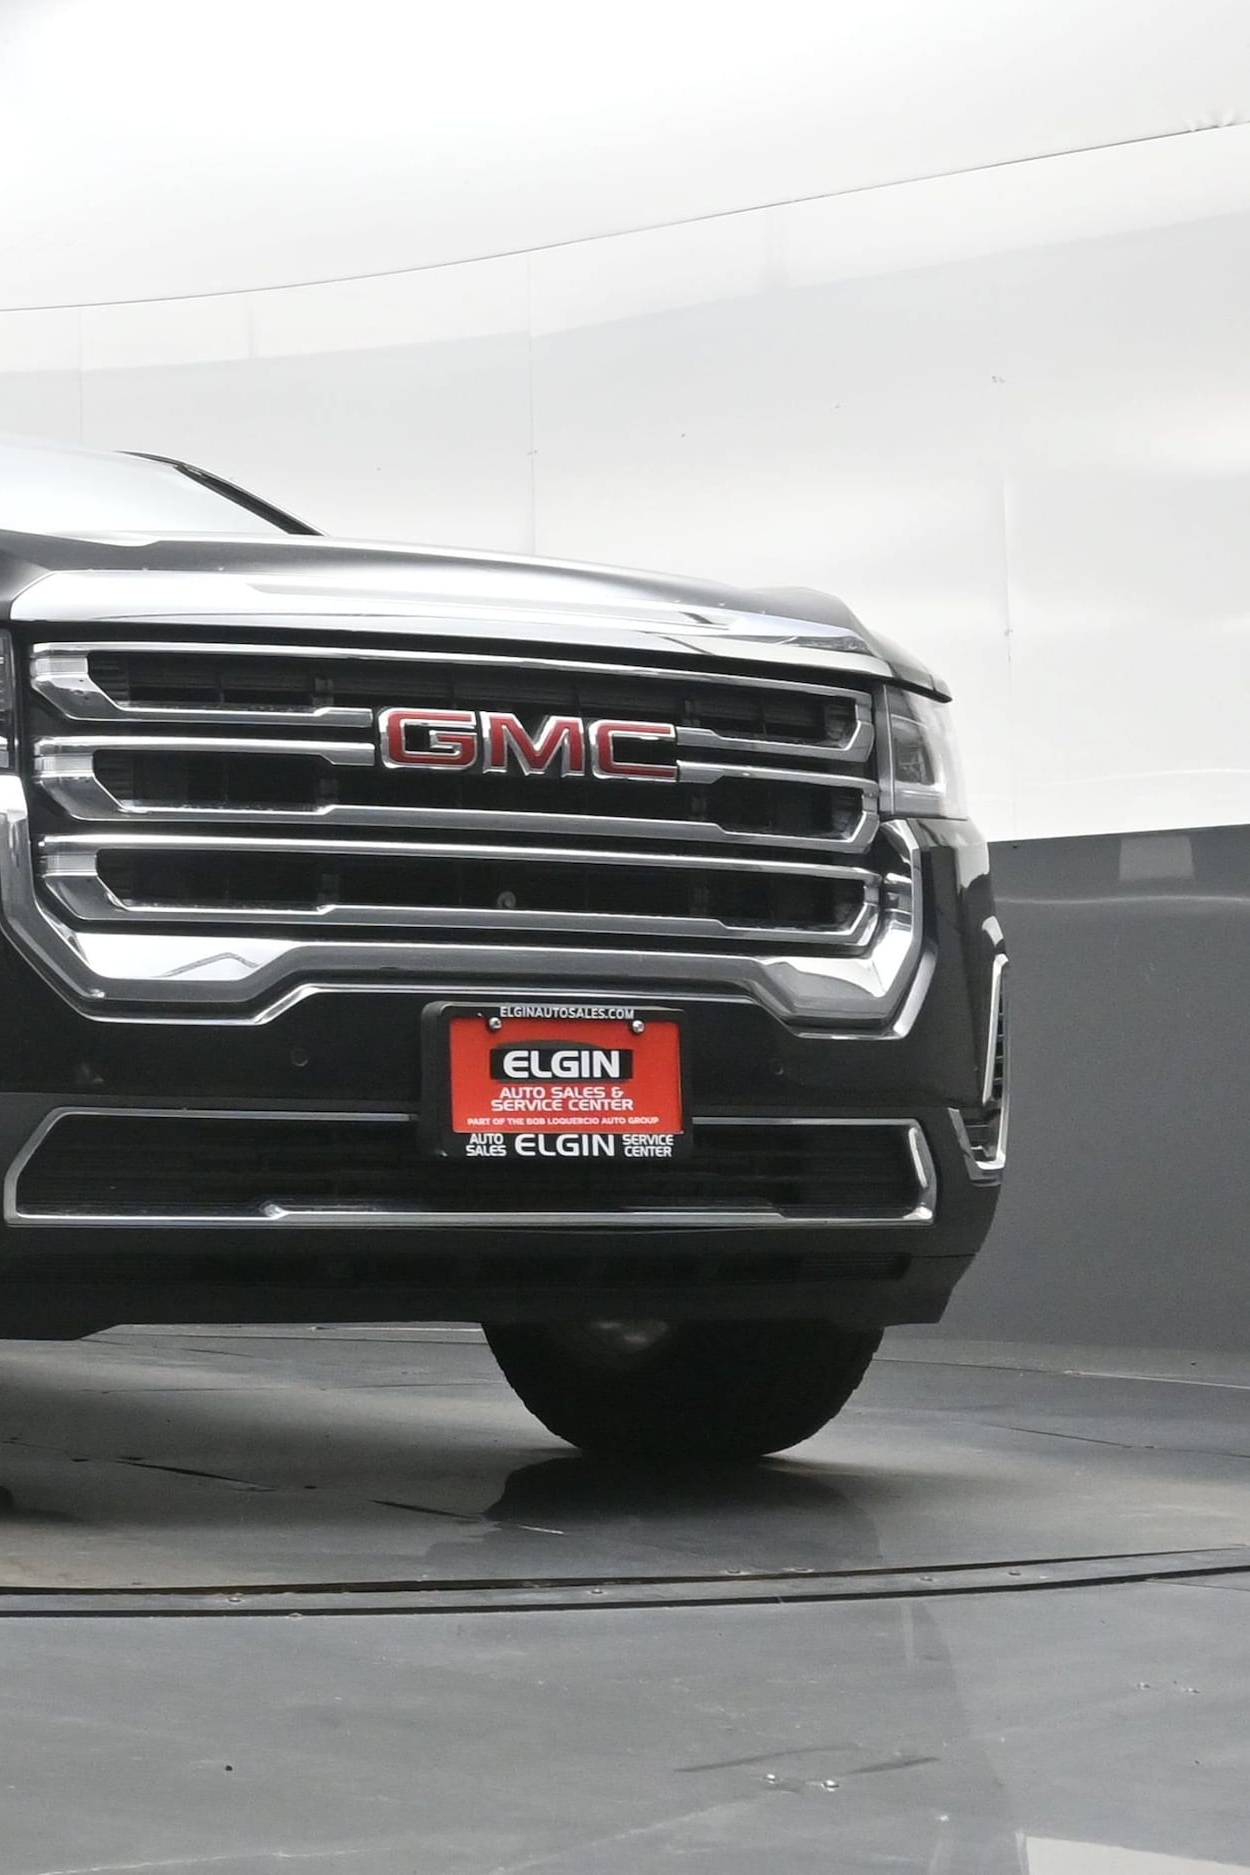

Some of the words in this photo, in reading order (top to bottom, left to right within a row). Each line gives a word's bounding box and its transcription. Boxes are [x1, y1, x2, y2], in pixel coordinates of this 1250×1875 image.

[378, 707, 678, 782] GMC
[499, 1006, 634, 1020] ELGINAUTOSALES.COM
[503, 1050, 620, 1078] ELGIN
[499, 1086, 546, 1099] AUTO
[551, 1087, 605, 1099] SALES
[611, 1087, 624, 1099] &
[491, 1099, 563, 1112] SERVICE
[568, 1099, 634, 1112] CENTER
[467, 1117, 491, 1126] PART
[492, 1117, 505, 1126] OF
[507, 1117, 525, 1126] THE
[526, 1117, 546, 1126] BOB
[601, 1116, 626, 1125] AUTO
[627, 1116, 660, 1125] GROUP
[469, 1133, 504, 1145] AUTO
[514, 1133, 615, 1157] ELGIN
[622, 1134, 674, 1146] SERVICE
[465, 1145, 507, 1157] SALES
[624, 1146, 672, 1157] CENTER
